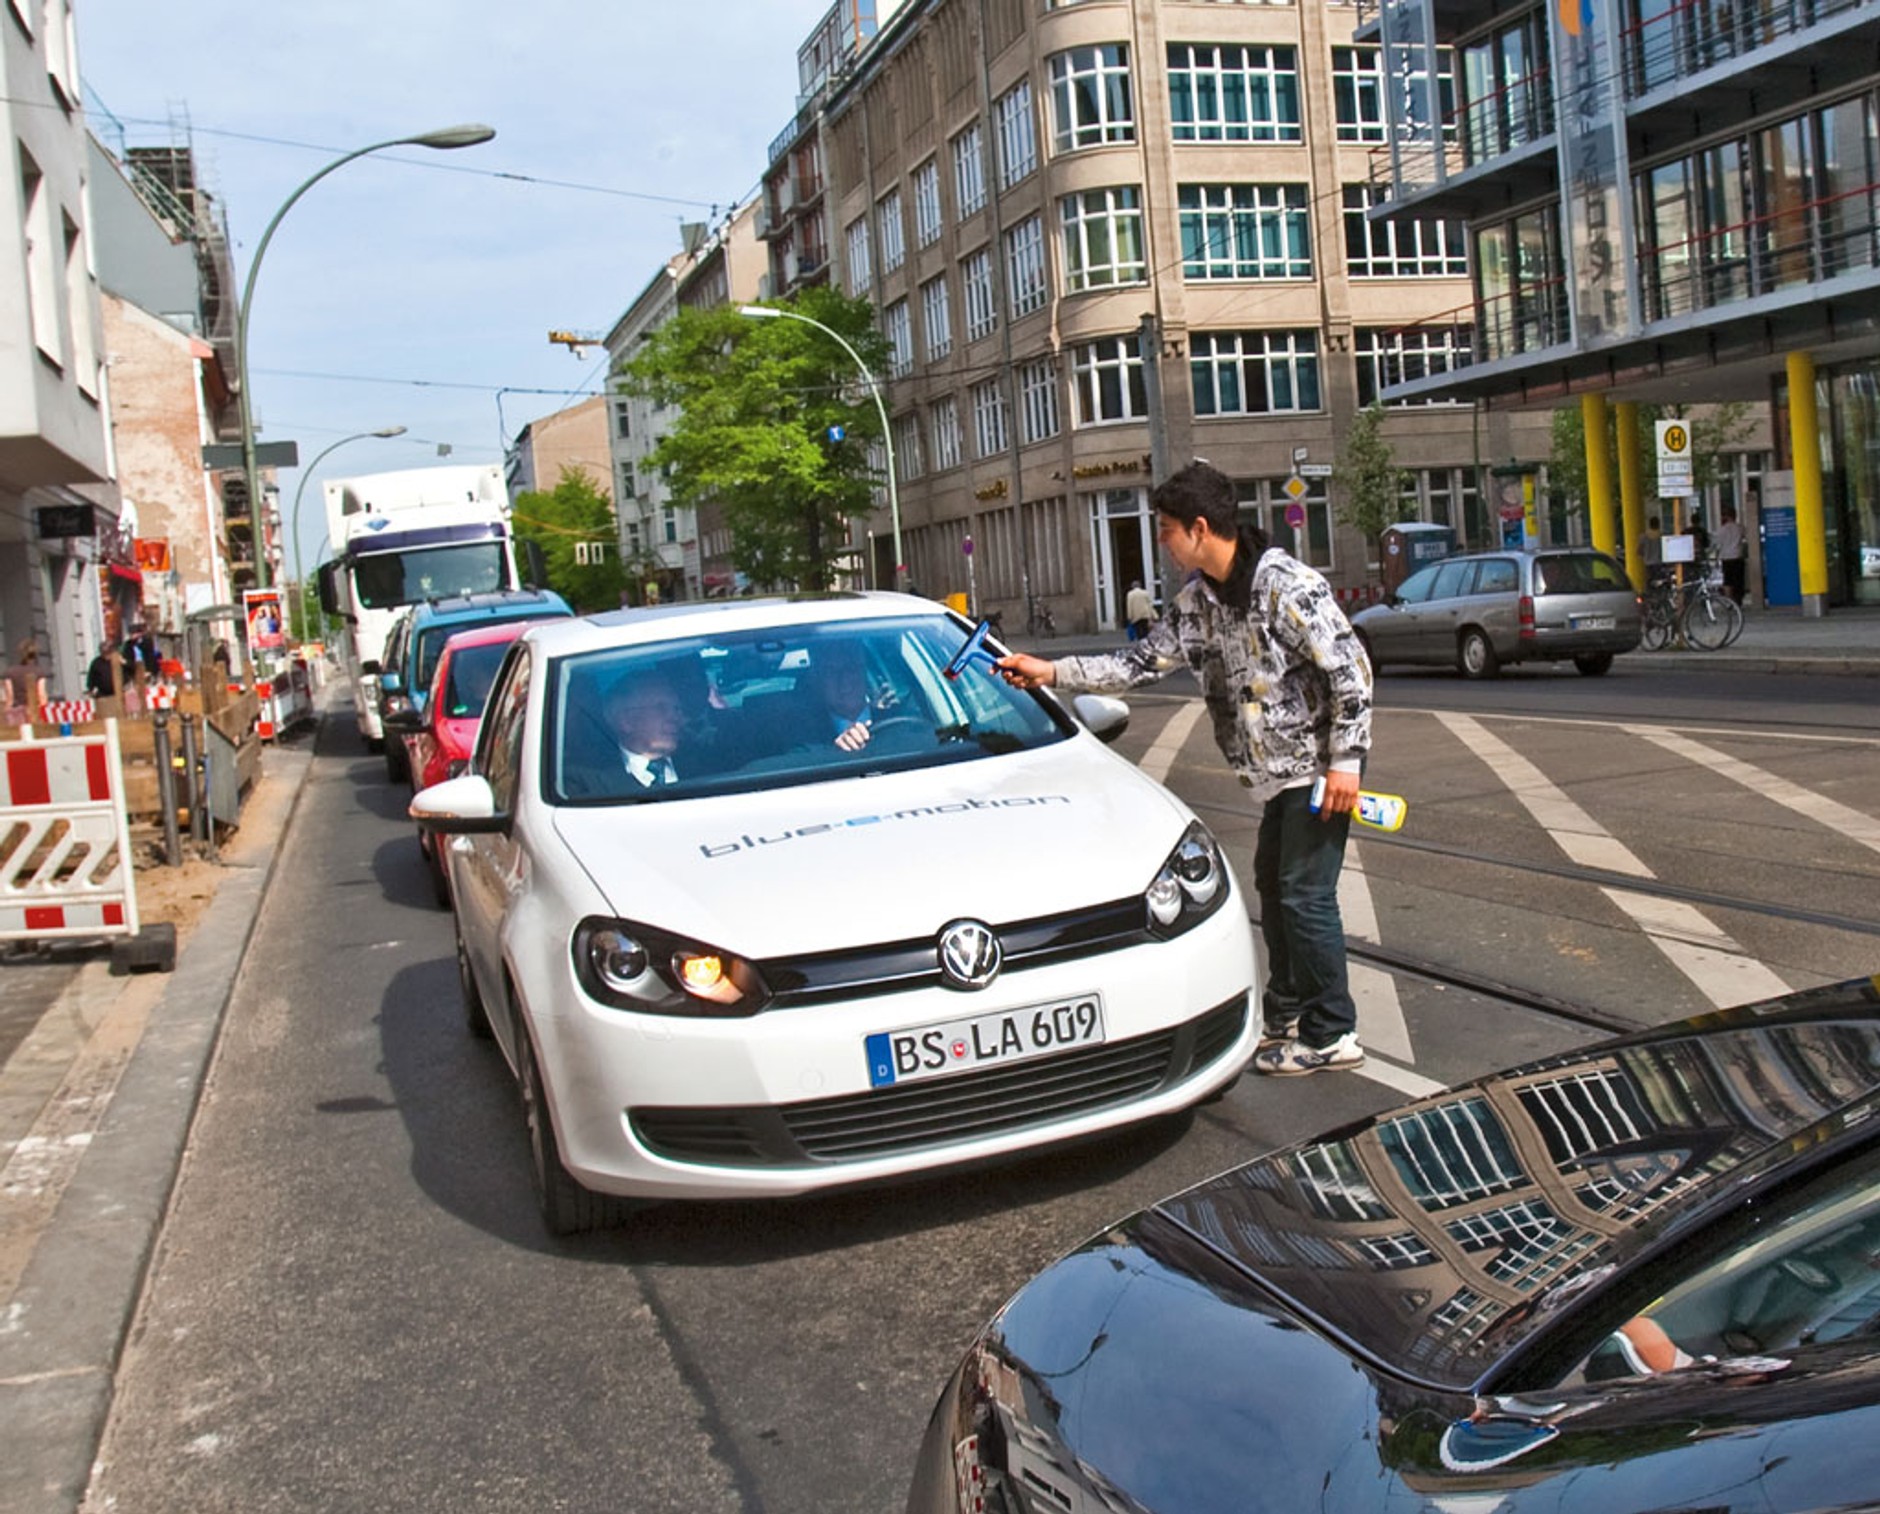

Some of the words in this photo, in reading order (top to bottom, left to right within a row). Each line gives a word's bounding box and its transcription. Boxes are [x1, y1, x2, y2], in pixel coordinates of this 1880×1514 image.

[1575, 45, 1606, 285] VATTENFALL
[876, 1063, 889, 1078] D
[892, 1030, 948, 1076] BS
[970, 1016, 1024, 1061] LA
[1031, 1001, 1098, 1049] 609
